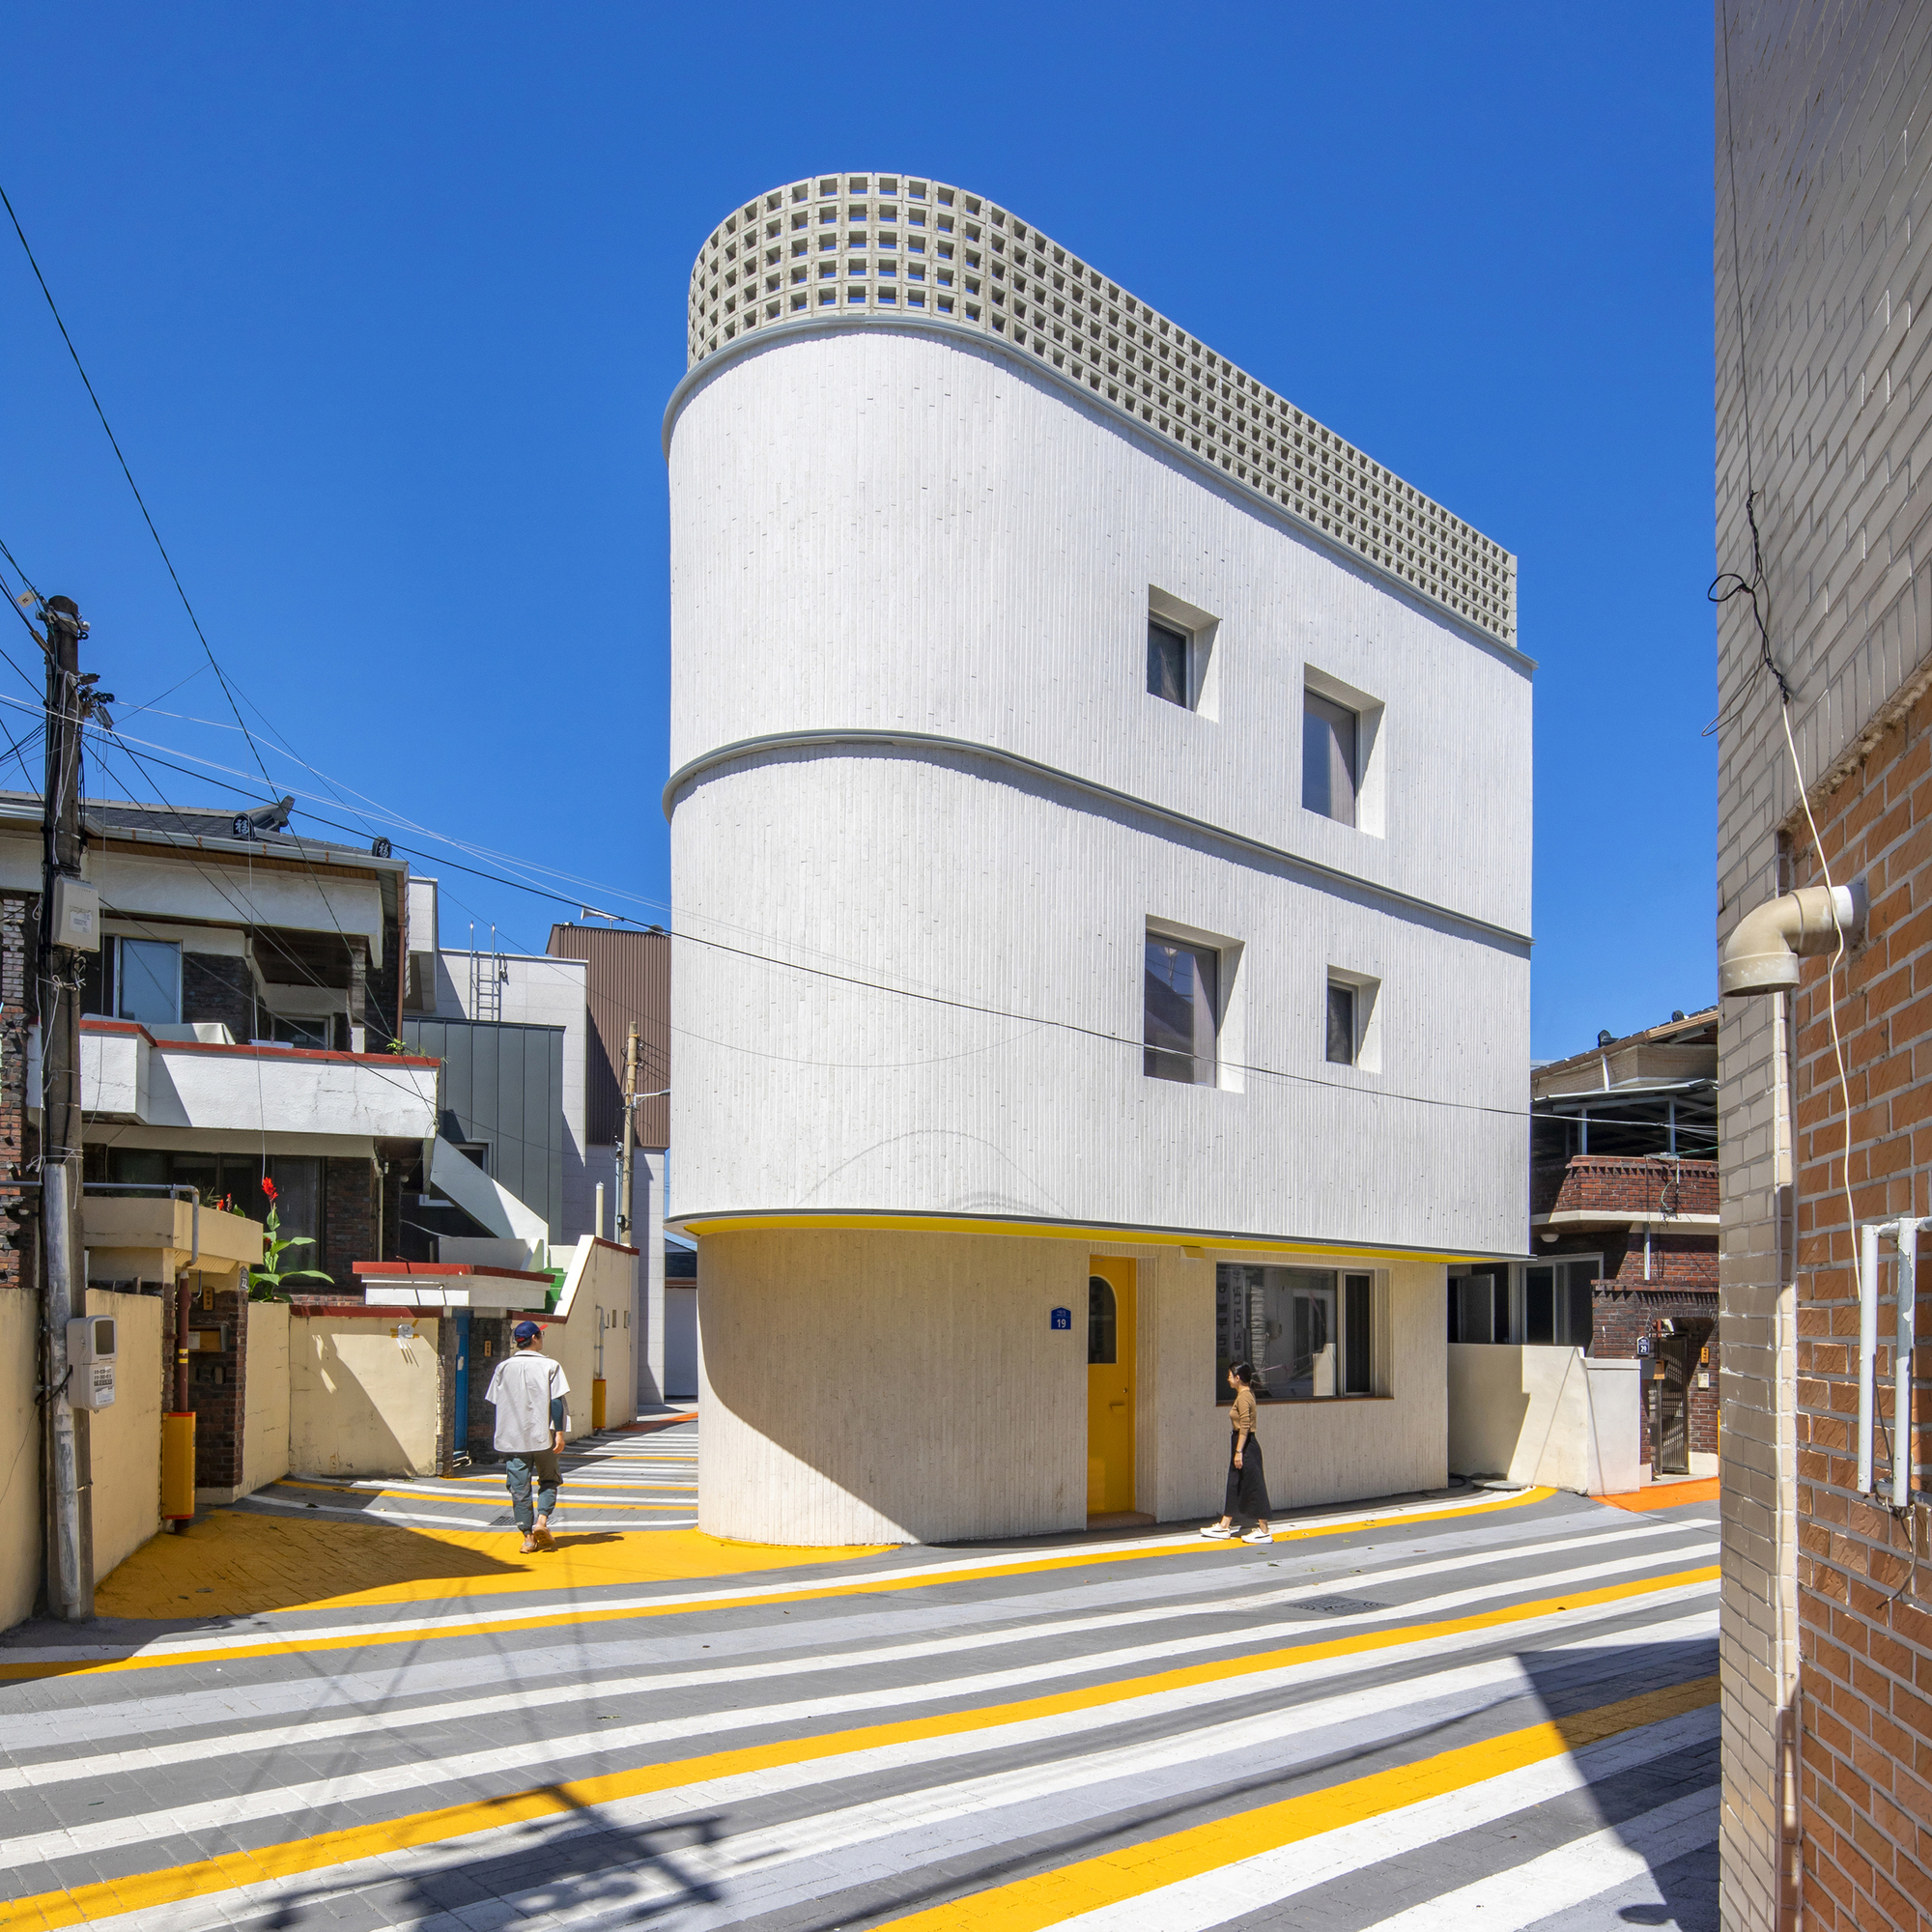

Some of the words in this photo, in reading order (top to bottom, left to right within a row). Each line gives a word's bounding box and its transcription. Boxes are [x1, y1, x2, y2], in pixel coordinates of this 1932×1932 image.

[242, 1278, 248, 1289] 22
[1057, 1319, 1066, 1328] 19
[1640, 1345, 1647, 1353] 29
